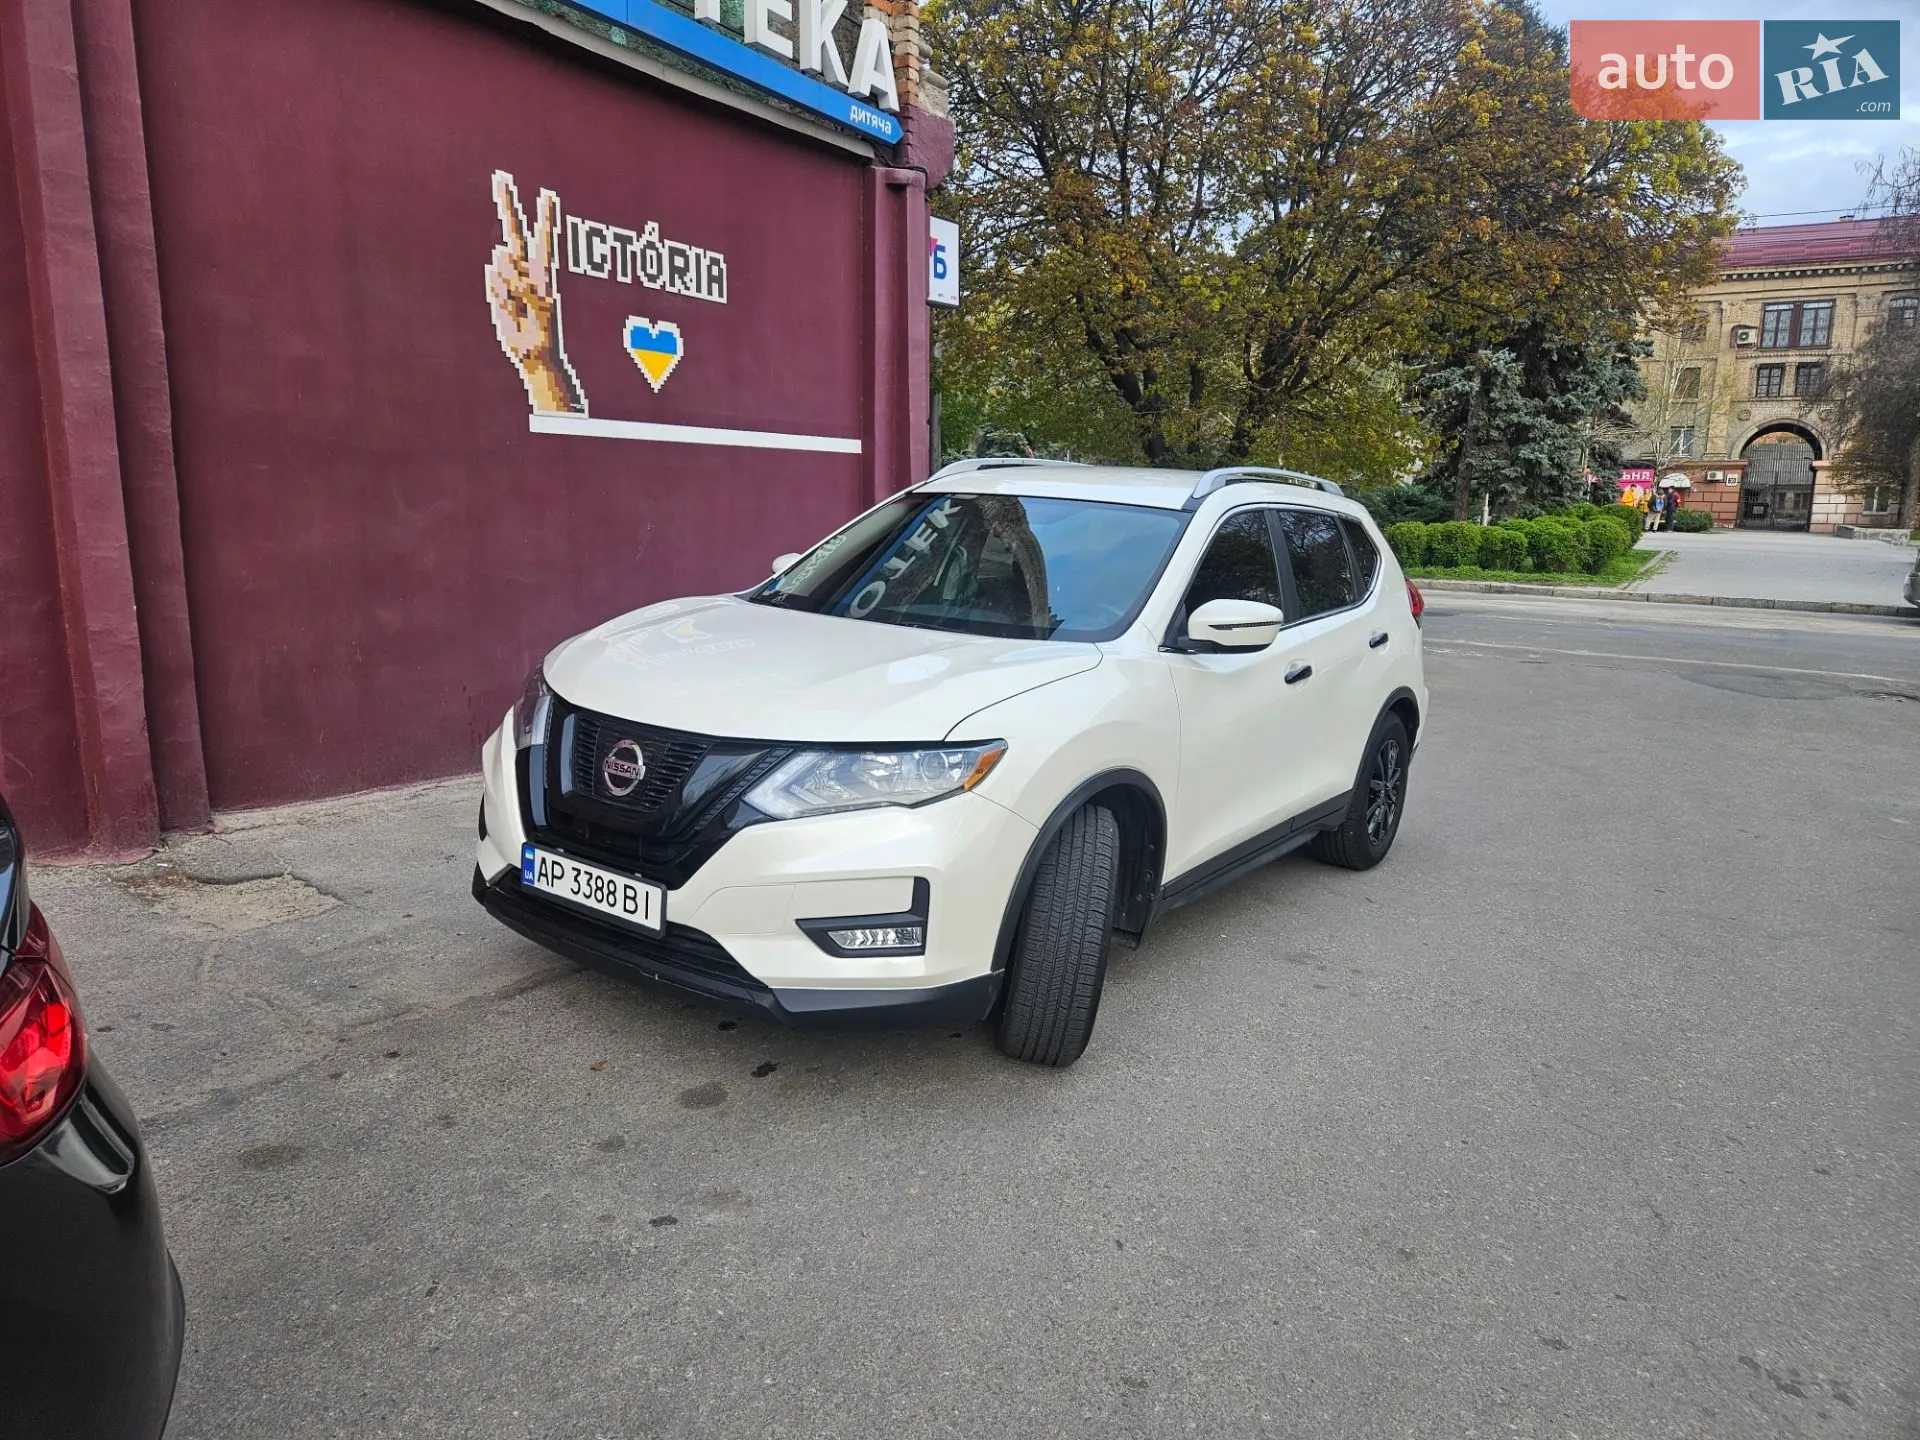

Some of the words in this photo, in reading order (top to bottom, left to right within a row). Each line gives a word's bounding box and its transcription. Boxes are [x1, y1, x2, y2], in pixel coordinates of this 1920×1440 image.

[694, 0, 901, 113] ЕКА
[850, 104, 893, 136] дитяча
[1620, 471, 1650, 480] ЬНЯ
[604, 760, 640, 777] NISSAN
[524, 870, 534, 881] UA
[537, 856, 565, 888] AP
[570, 866, 617, 908] 3388
[623, 883, 650, 920] BI
